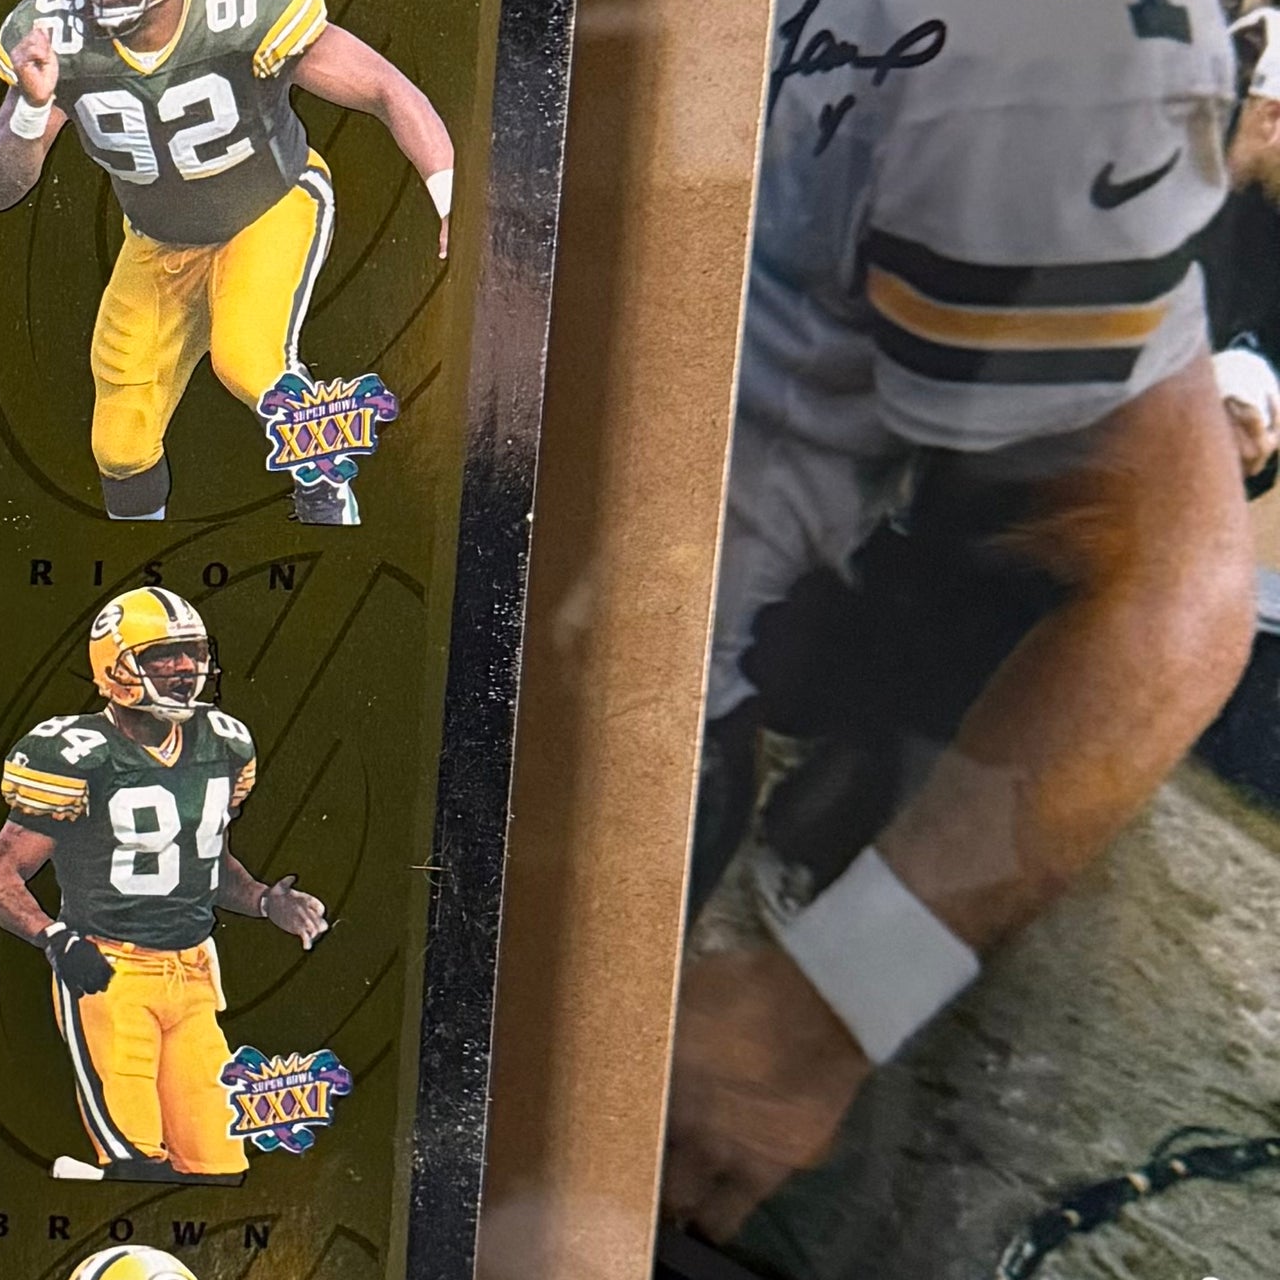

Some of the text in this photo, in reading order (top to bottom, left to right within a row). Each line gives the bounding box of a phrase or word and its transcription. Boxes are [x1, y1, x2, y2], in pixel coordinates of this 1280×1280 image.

[74, 72, 255, 184] 92
[293, 398, 358, 423] SUPER BOWL
[275, 408, 373, 463] XXXI
[29, 558, 296, 591] RISON
[235, 1082, 329, 1130] XXXI
